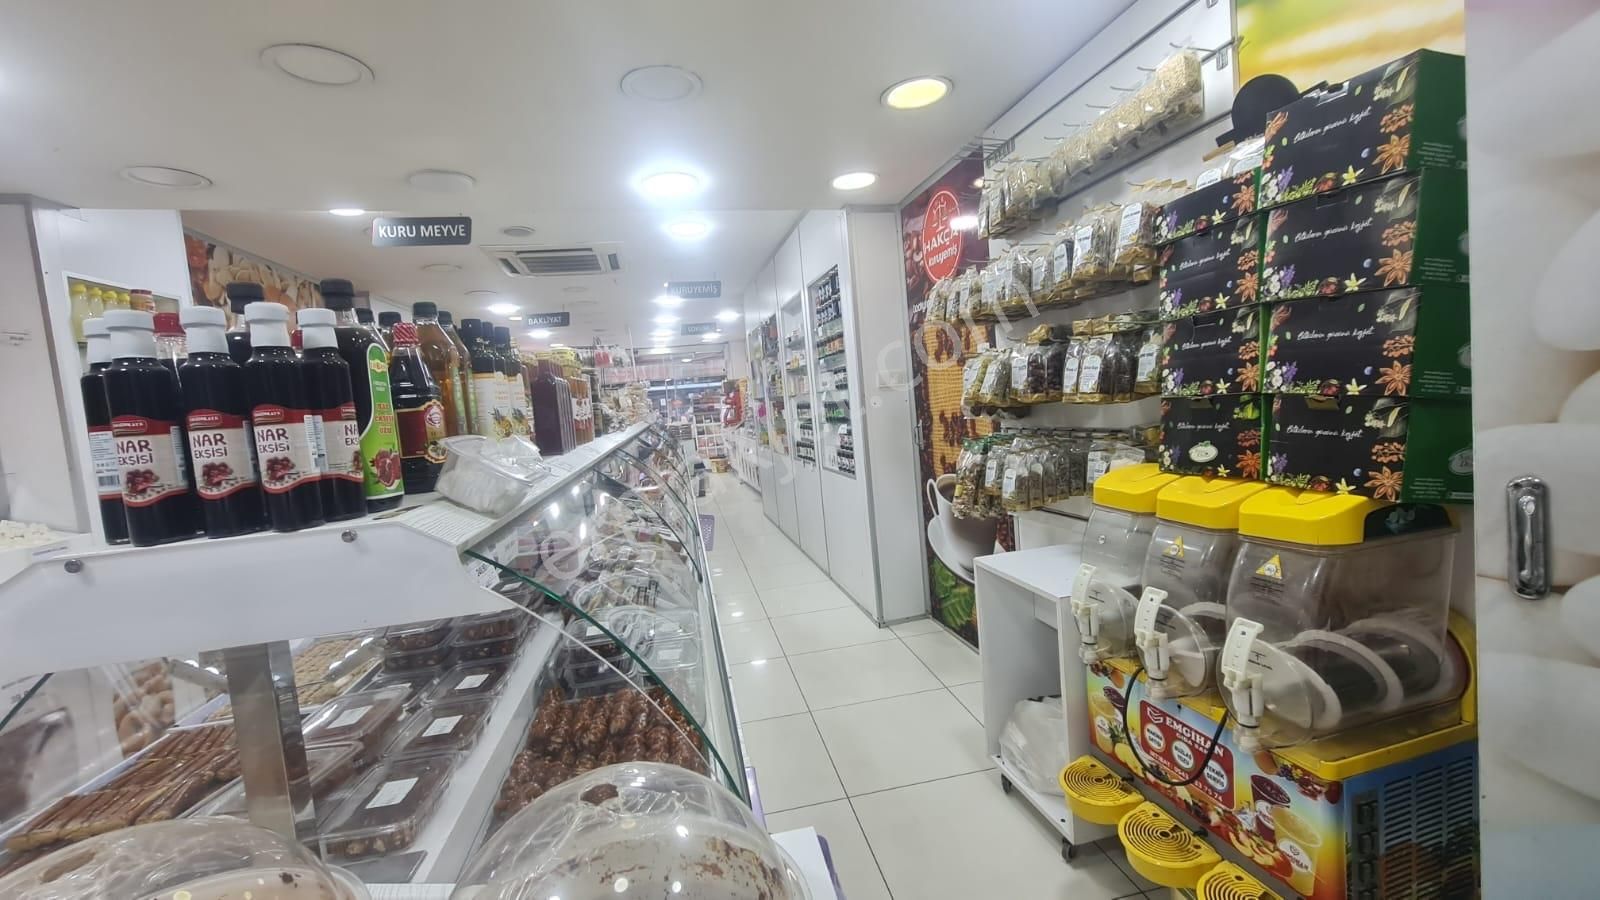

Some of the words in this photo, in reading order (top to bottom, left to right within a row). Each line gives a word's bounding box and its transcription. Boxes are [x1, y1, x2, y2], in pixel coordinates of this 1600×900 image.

[378, 225, 417, 238] KURU
[420, 224, 466, 238] MEYVE
[193, 433, 227, 449] NAR
[257, 428, 289, 443] NAR
[117, 440, 152, 455] NAR
[194, 447, 228, 460] EKŞİSİ
[258, 441, 290, 454] EKŞİSİ
[118, 453, 153, 466] EKŞİSİ
